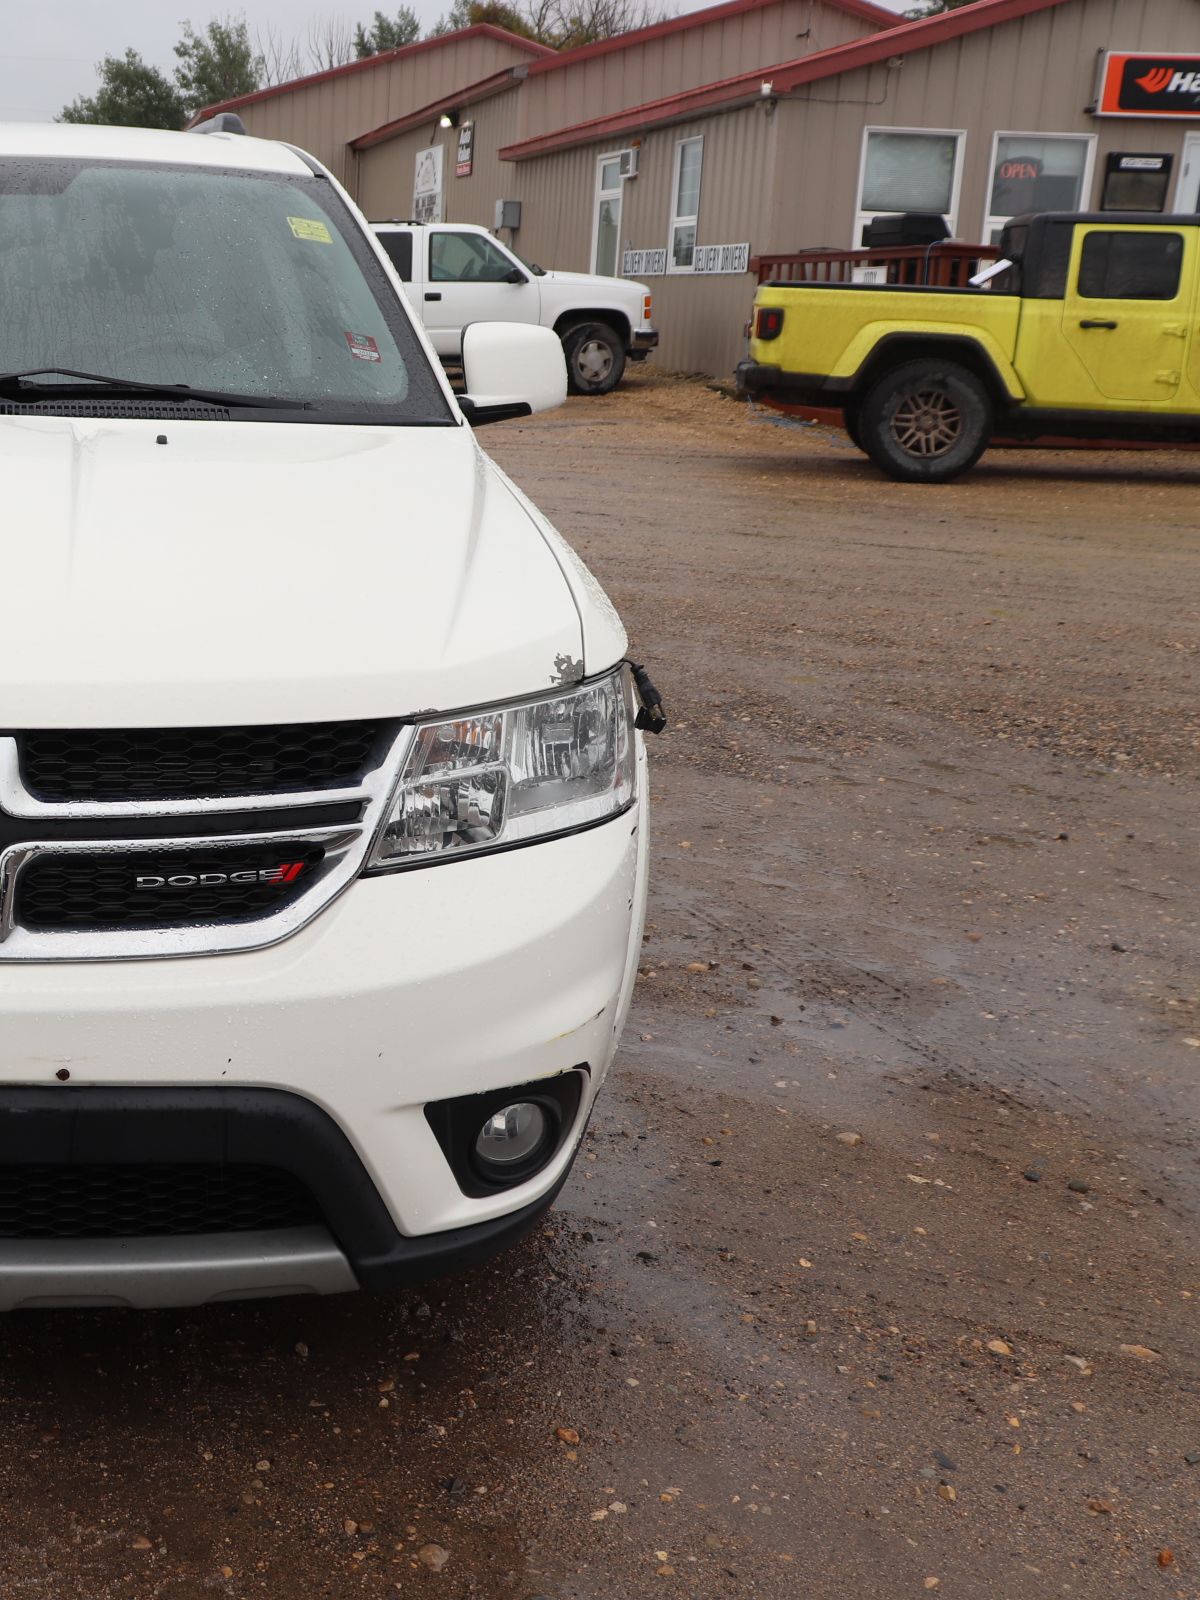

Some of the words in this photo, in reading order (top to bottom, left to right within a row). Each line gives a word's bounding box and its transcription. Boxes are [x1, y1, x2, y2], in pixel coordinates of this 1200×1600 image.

[1001, 162, 1038, 179] OPEN
[623, 251, 644, 274] DELIVERY
[644, 250, 665, 273] DRIVERS
[694, 247, 720, 272] DELIVERY
[720, 245, 747, 271] DRIVERS
[136, 868, 284, 888] DODGE
